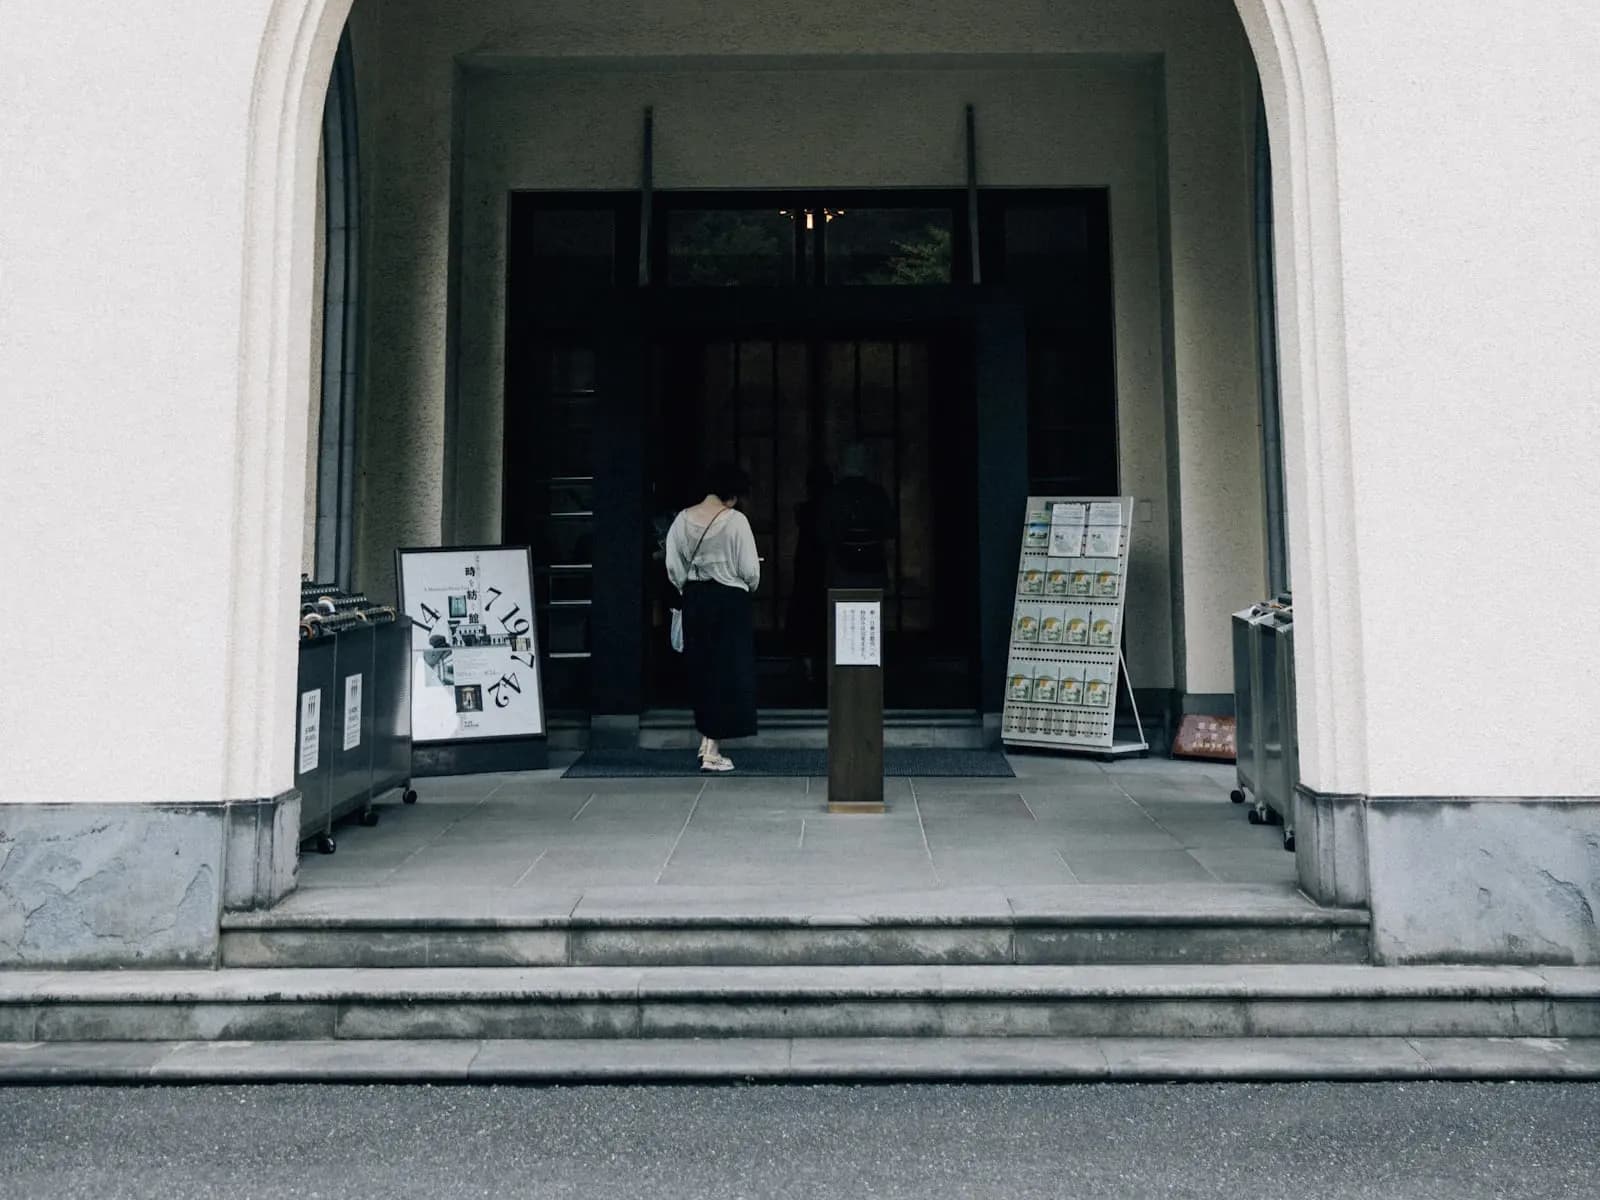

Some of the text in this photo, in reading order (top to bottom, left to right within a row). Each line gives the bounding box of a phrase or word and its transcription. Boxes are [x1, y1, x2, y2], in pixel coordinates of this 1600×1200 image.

[484, 587, 502, 611] 7
[498, 602, 529, 636] 19
[510, 653, 535, 669] 7
